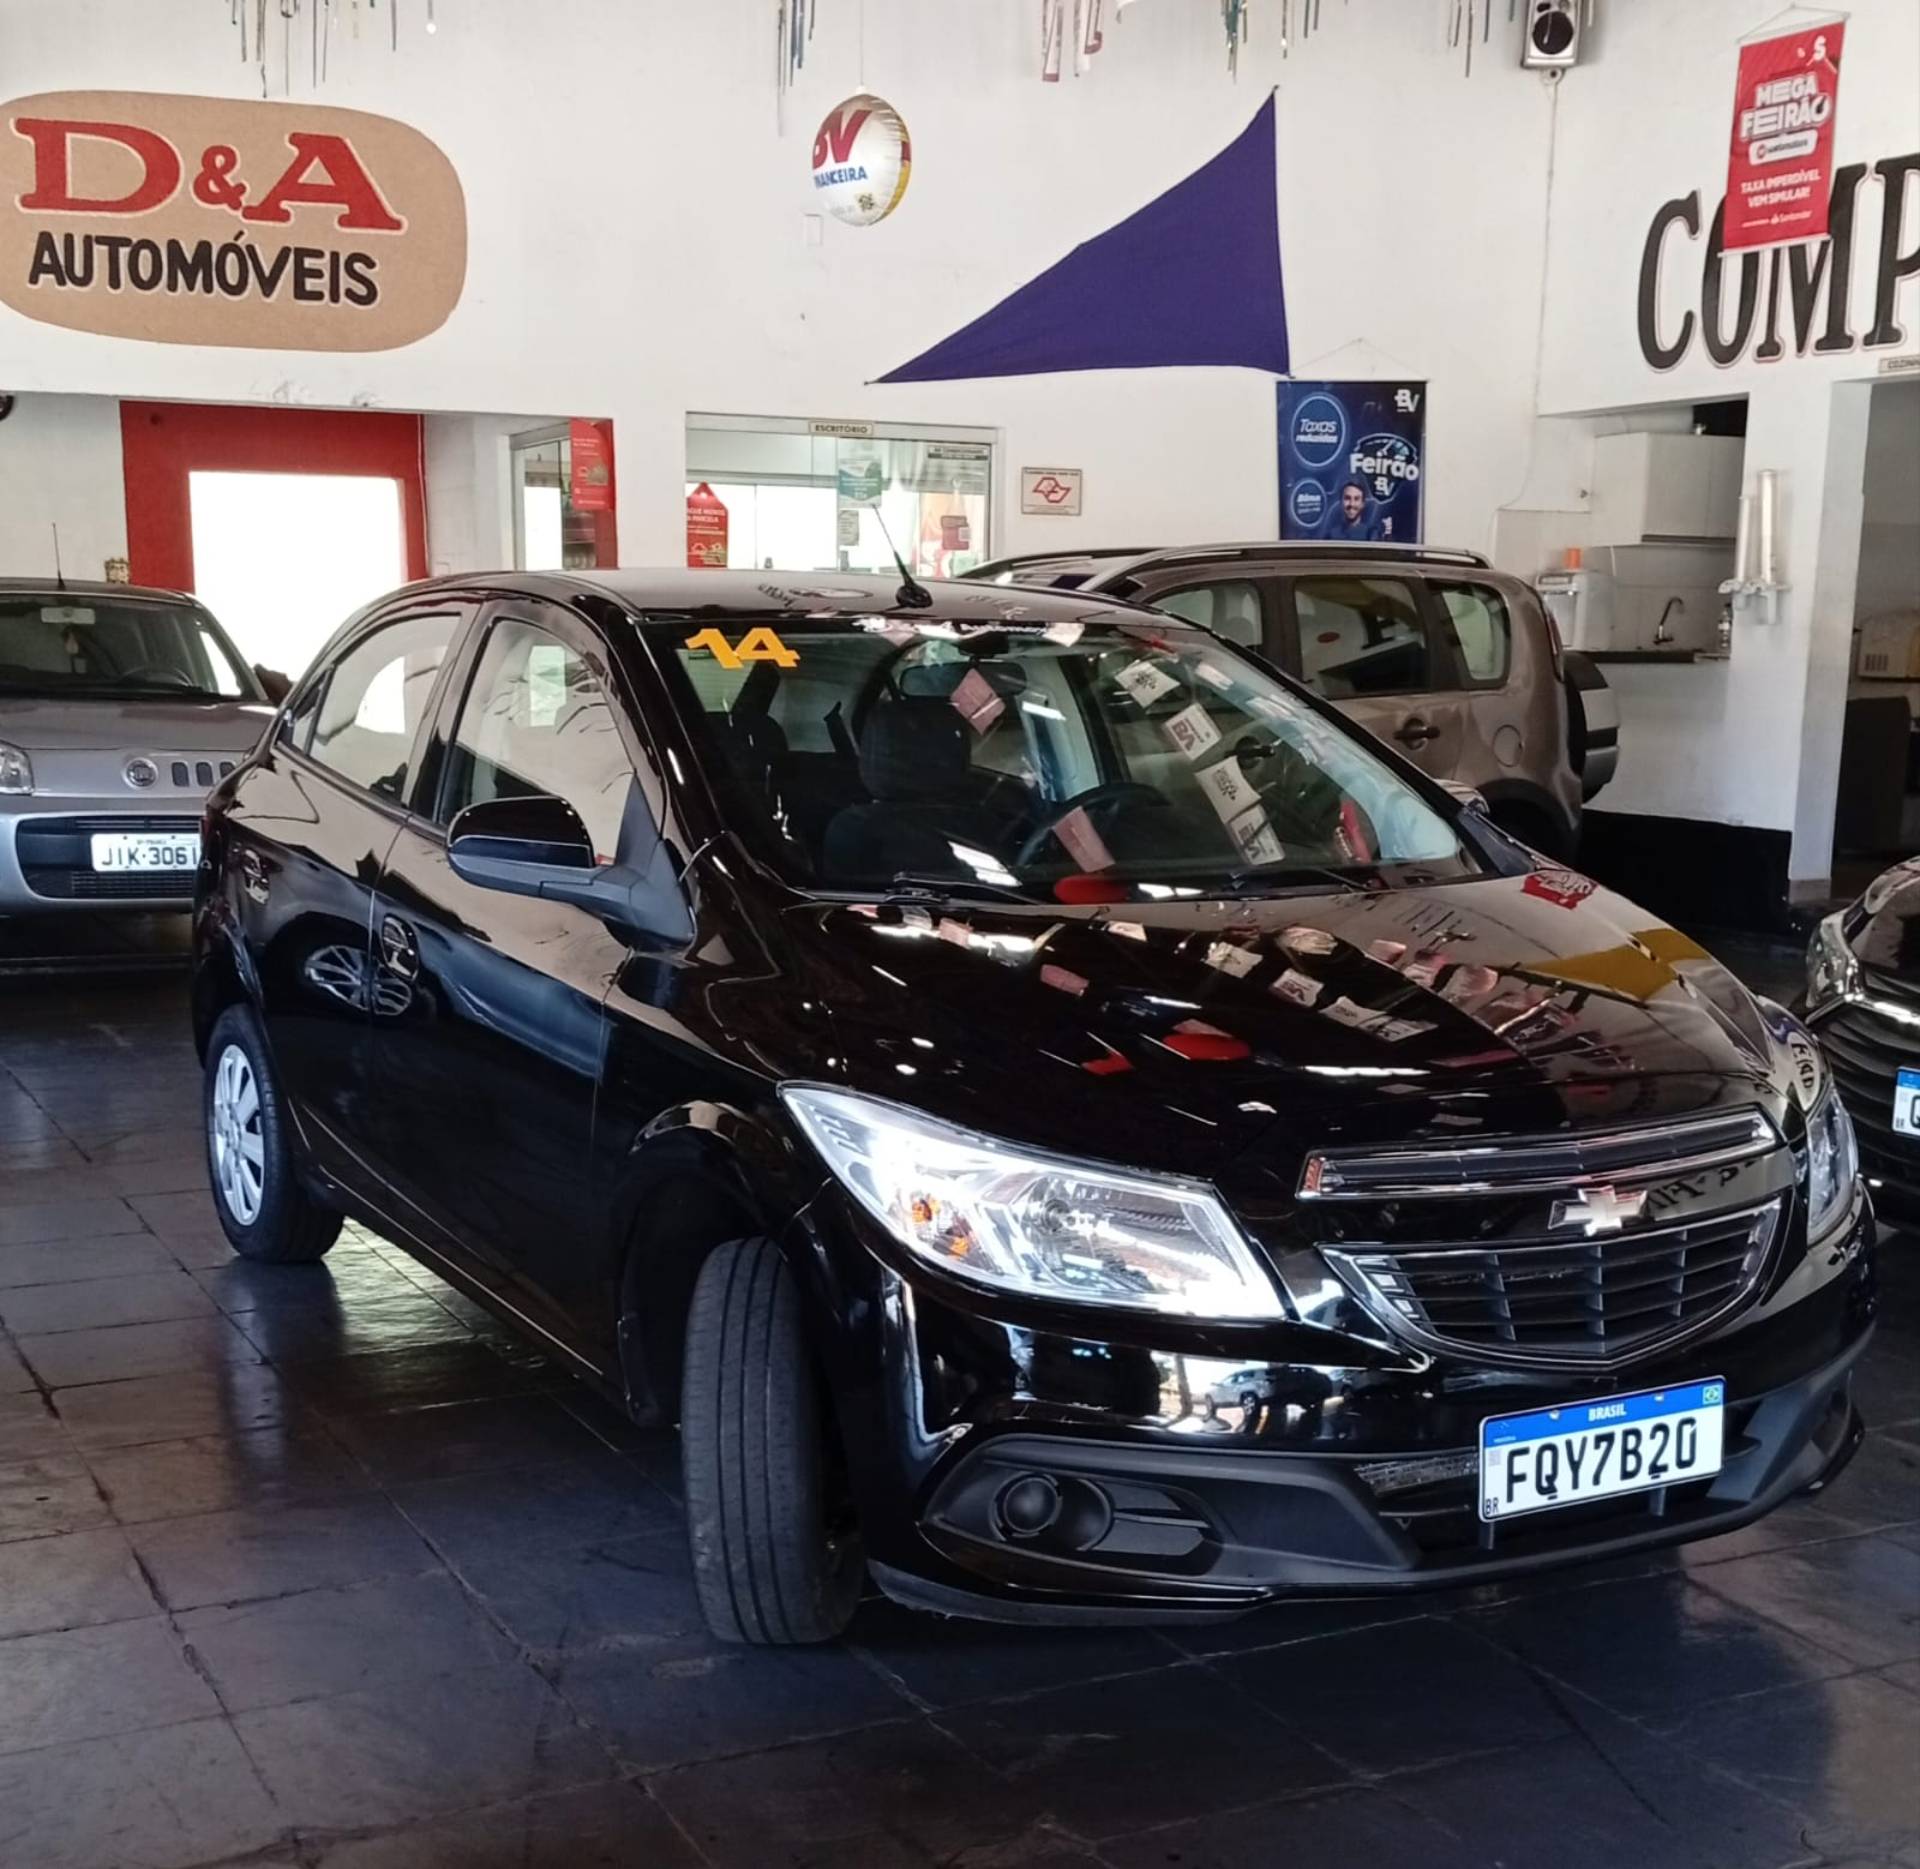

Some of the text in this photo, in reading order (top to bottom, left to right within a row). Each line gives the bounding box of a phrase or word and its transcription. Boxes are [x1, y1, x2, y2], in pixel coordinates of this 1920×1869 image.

[1755, 73, 1818, 107] MEGA
[1740, 94, 1830, 140] FEIRÃO
[15, 117, 403, 232] D&A
[1741, 169, 1821, 194] TAXA IMPERDÍVEL
[1748, 194, 1769, 208] VEM
[28, 230, 378, 306] AUTOMÓVEIS
[815, 425, 868, 434] ESCRITÓRIO
[1300, 419, 1337, 433] Taxas
[1351, 451, 1419, 480] Feirão
[685, 628, 800, 669] 14
[1588, 1403, 1626, 1422] BRASIL
[1506, 1416, 1697, 1503] FQY7B20
[1485, 1497, 1499, 1515] BR
